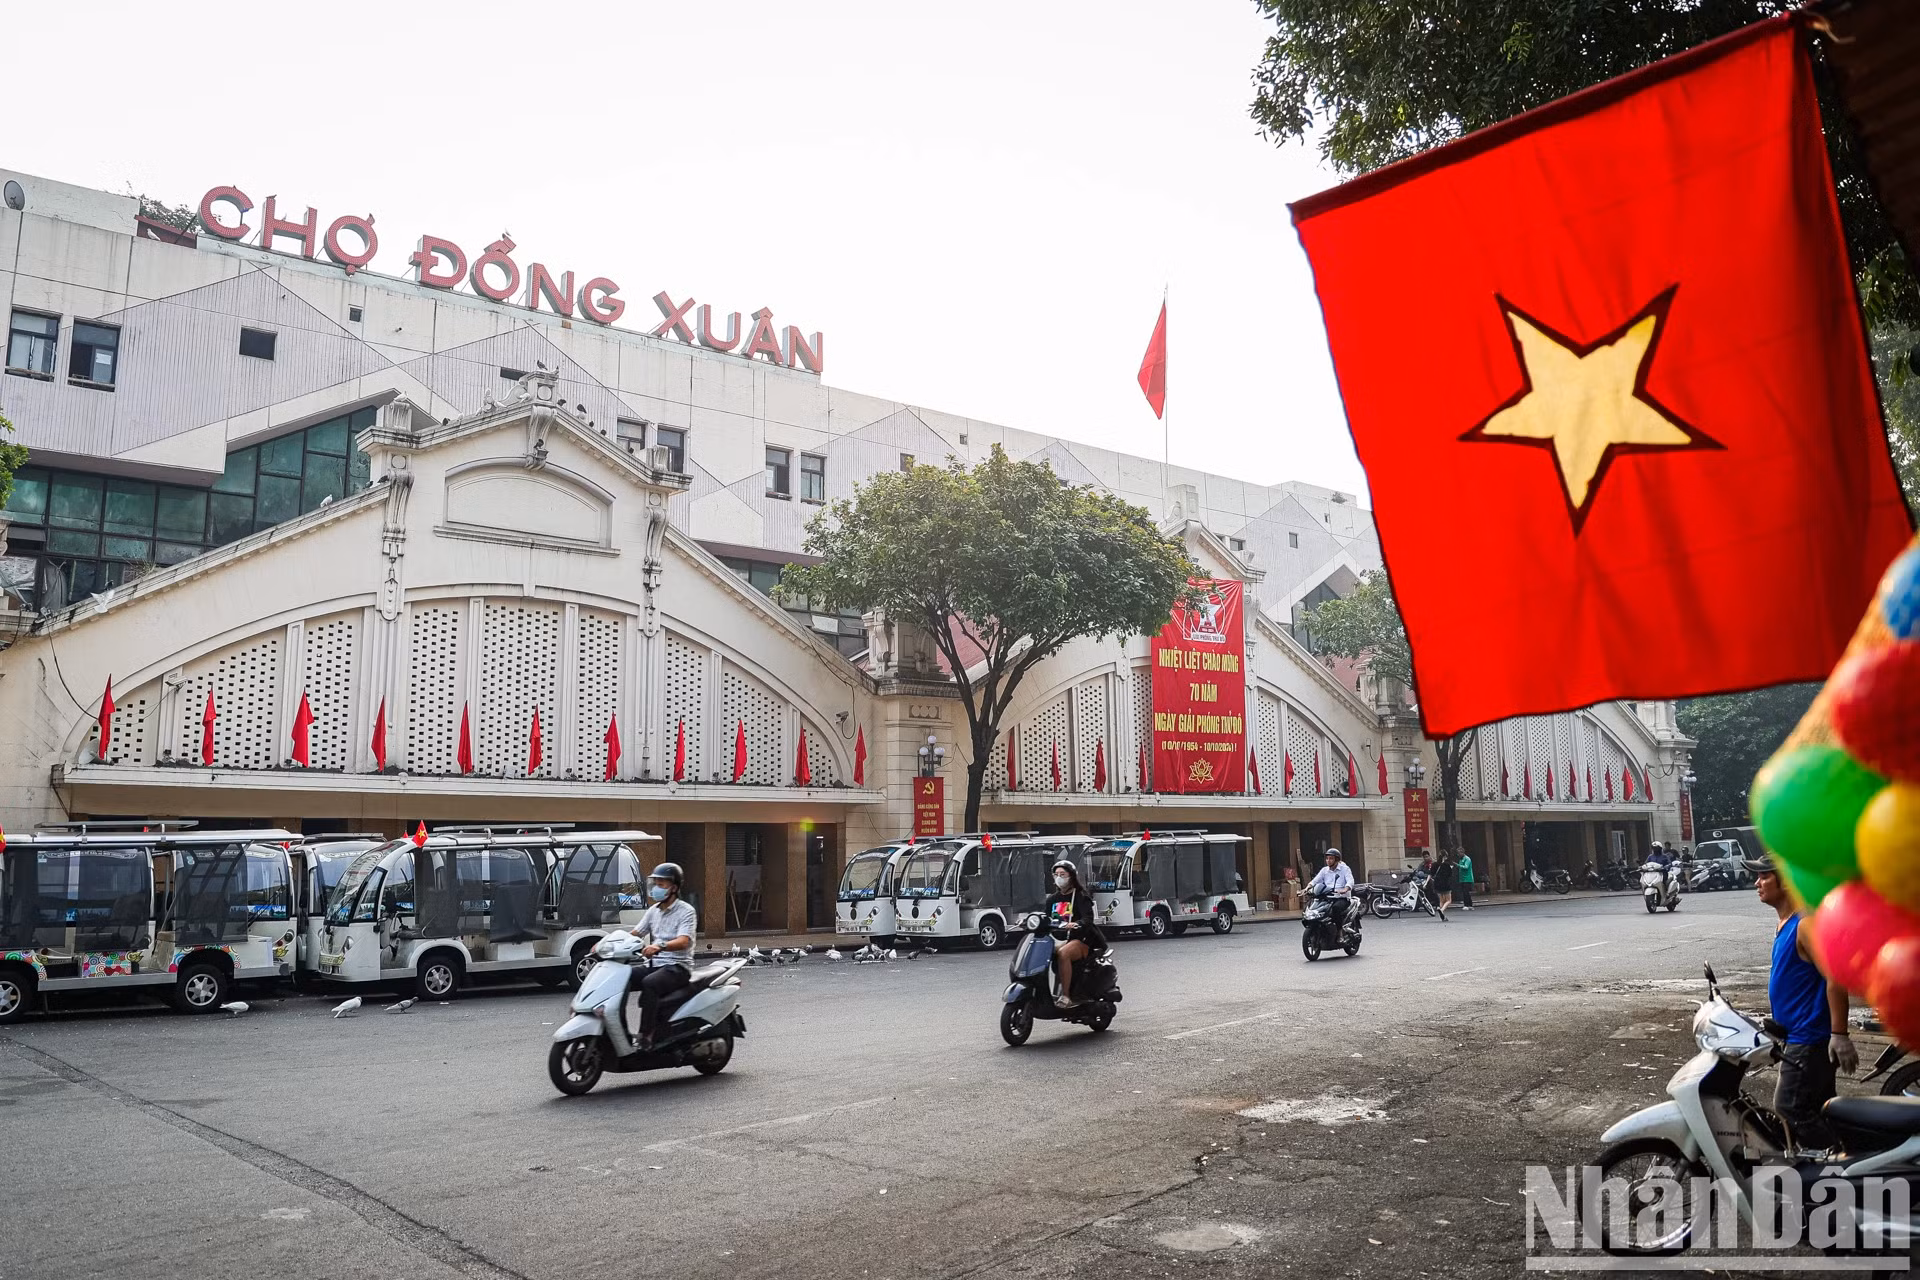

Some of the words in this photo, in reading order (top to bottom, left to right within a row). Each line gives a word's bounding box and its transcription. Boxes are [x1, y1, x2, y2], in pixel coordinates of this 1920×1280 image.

[198, 185, 378, 276] CHỢ
[409, 234, 626, 324] ĐỒNG
[652, 291, 824, 373] XUÂN
[1159, 646, 1182, 672] NHIỆT
[1184, 648, 1200, 673] LIỆT
[1202, 649, 1221, 672] CHÀO
[1221, 650, 1239, 673] MỪNG
[1190, 683, 1199, 701] 70
[1201, 680, 1218, 702] NĂM
[1154, 708, 1177, 732] NGÀY
[1178, 708, 1195, 733] GIẢI
[1196, 711, 1220, 734] PHÓNG
[1220, 709, 1232, 734] THỦ
[1232, 712, 1243, 735] ĐÔ
